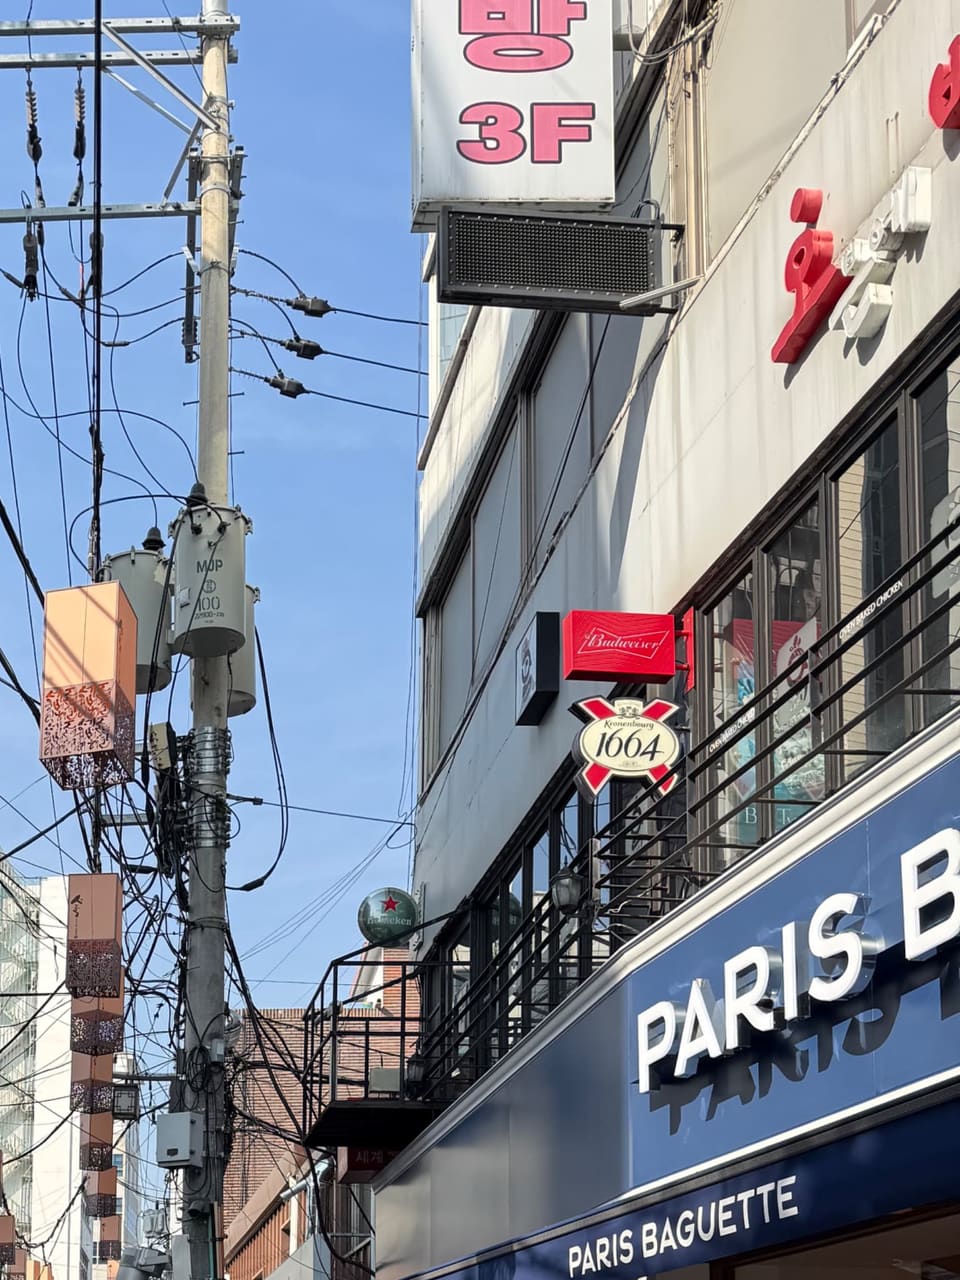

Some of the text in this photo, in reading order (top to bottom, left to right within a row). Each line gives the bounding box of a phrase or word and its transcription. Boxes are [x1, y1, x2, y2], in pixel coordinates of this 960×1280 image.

[456, 101, 595, 165] 3F
[839, 580, 904, 639] OVEN BAKED CHICKEN
[585, 633, 661, 651] Budweiser
[595, 727, 665, 762] 1664
[603, 719, 655, 731] Kronenbourg
[637, 892, 874, 1093] PARIS
[568, 1175, 800, 1279] PARIS BAGUETTE
